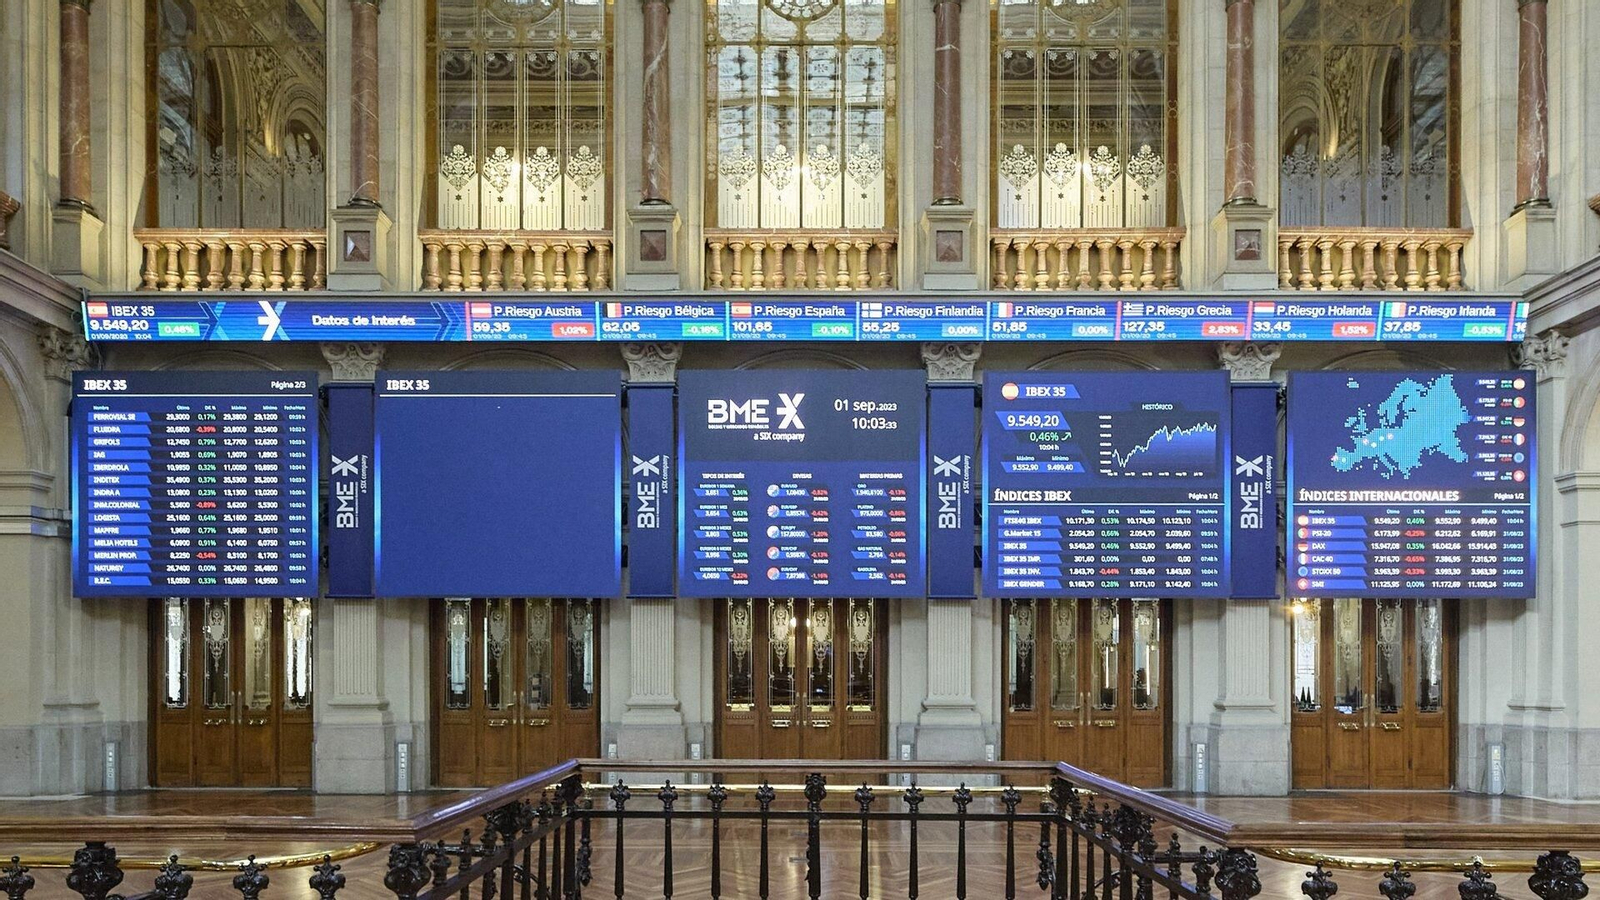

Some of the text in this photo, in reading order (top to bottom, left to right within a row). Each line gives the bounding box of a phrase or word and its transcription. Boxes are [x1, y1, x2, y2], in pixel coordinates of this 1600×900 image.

[111, 306, 155, 316] IBEX 35
[494, 305, 582, 318] P.Riesgo Austria
[624, 305, 714, 318] P.Riesgo Bélgica
[754, 305, 845, 318] P.Riesgo España
[884, 306, 984, 318] P.Riesgo Finlandia
[1015, 306, 1106, 318] P.Riesgo Francia
[1146, 305, 1232, 318] P.Riesgo Grecia
[1277, 305, 1373, 318] P.Riesgo Holanda
[1408, 305, 1496, 318] P.Riesgo Irlanda
[90, 320, 149, 331] 9.549,20
[312, 314, 415, 326] Datos de Interés
[473, 322, 588, 335] 59,35 1,02%
[602, 322, 640, 333] 62,05
[732, 321, 849, 334] 101,65 -0,10%
[862, 322, 978, 335] 55,25 0,00%
[1078, 326, 1108, 335] 0,00%
[1122, 321, 1239, 334] 127,35 2,83%
[1253, 321, 1369, 335] 33,45 1,52%
[1383, 321, 1421, 333] 37,85
[83, 380, 127, 390] IBEX 35
[271, 381, 307, 390] Página 2/3
[386, 380, 430, 391] IBEX 35
[1025, 387, 1066, 397] IBEX 35
[707, 399, 770, 424] BME
[834, 399, 849, 411] 01
[852, 417, 898, 430] 10:03:33
[1007, 415, 1060, 428] 9.549,20
[759, 432, 772, 441] SIX
[772, 432, 805, 442] company
[1029, 432, 1060, 442] 0,46%
[994, 489, 1072, 501] ÍNDICES IBEX
[1300, 489, 1460, 501] ÍNDICES INTERNACIONALES
[336, 481, 354, 528] BME
[637, 482, 655, 528] BME
[938, 482, 956, 528] BME
[1240, 482, 1258, 528] BME
